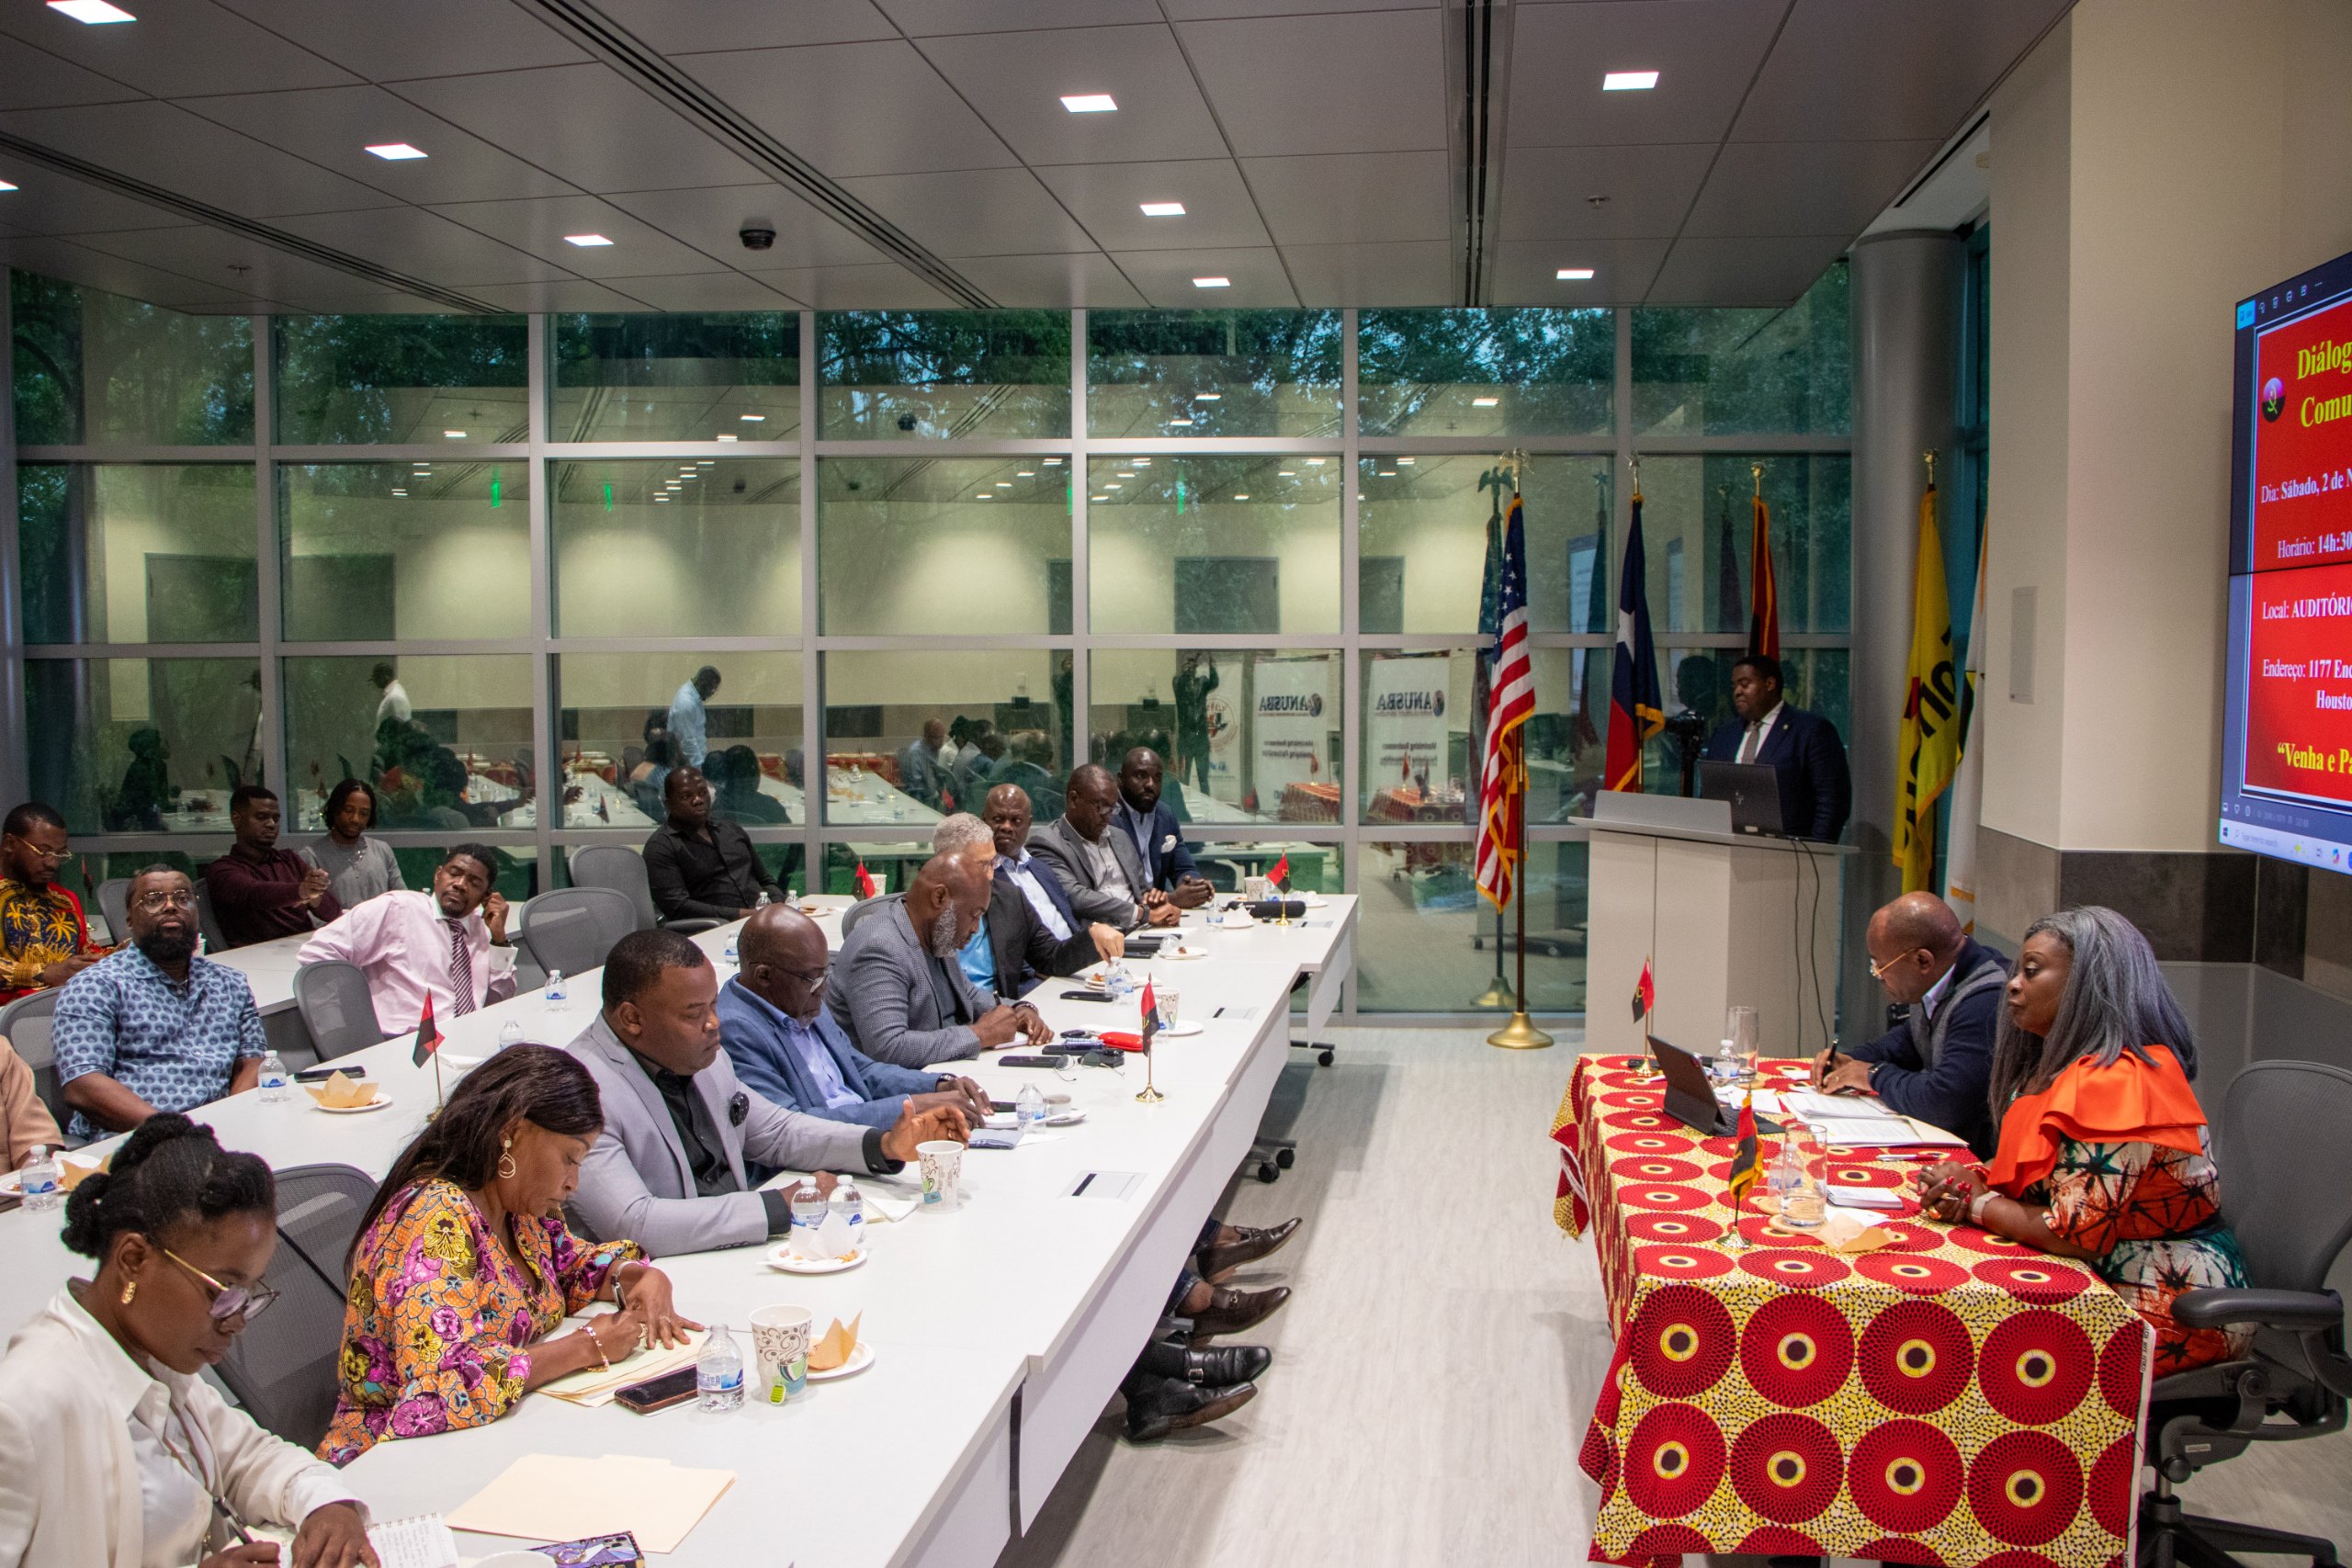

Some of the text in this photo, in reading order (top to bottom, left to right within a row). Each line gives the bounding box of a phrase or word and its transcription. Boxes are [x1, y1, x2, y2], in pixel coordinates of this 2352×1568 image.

[2298, 340, 2352, 379] Diálog
[2301, 394, 2352, 427] Comu
[2261, 484, 2278, 503] Dia:
[2280, 476, 2320, 500] Sábado,
[2322, 472, 2328, 491] 2
[2331, 470, 2344, 491] de
[2278, 531, 2352, 558] Horário: 14h:30
[2262, 592, 2352, 619] Local: AUDITÓRI
[2262, 659, 2306, 682] Endereço:
[2309, 660, 2332, 678] 1177
[2316, 690, 2352, 711] Housto
[2278, 742, 2324, 771] “Venha
[2327, 754, 2335, 773] e
